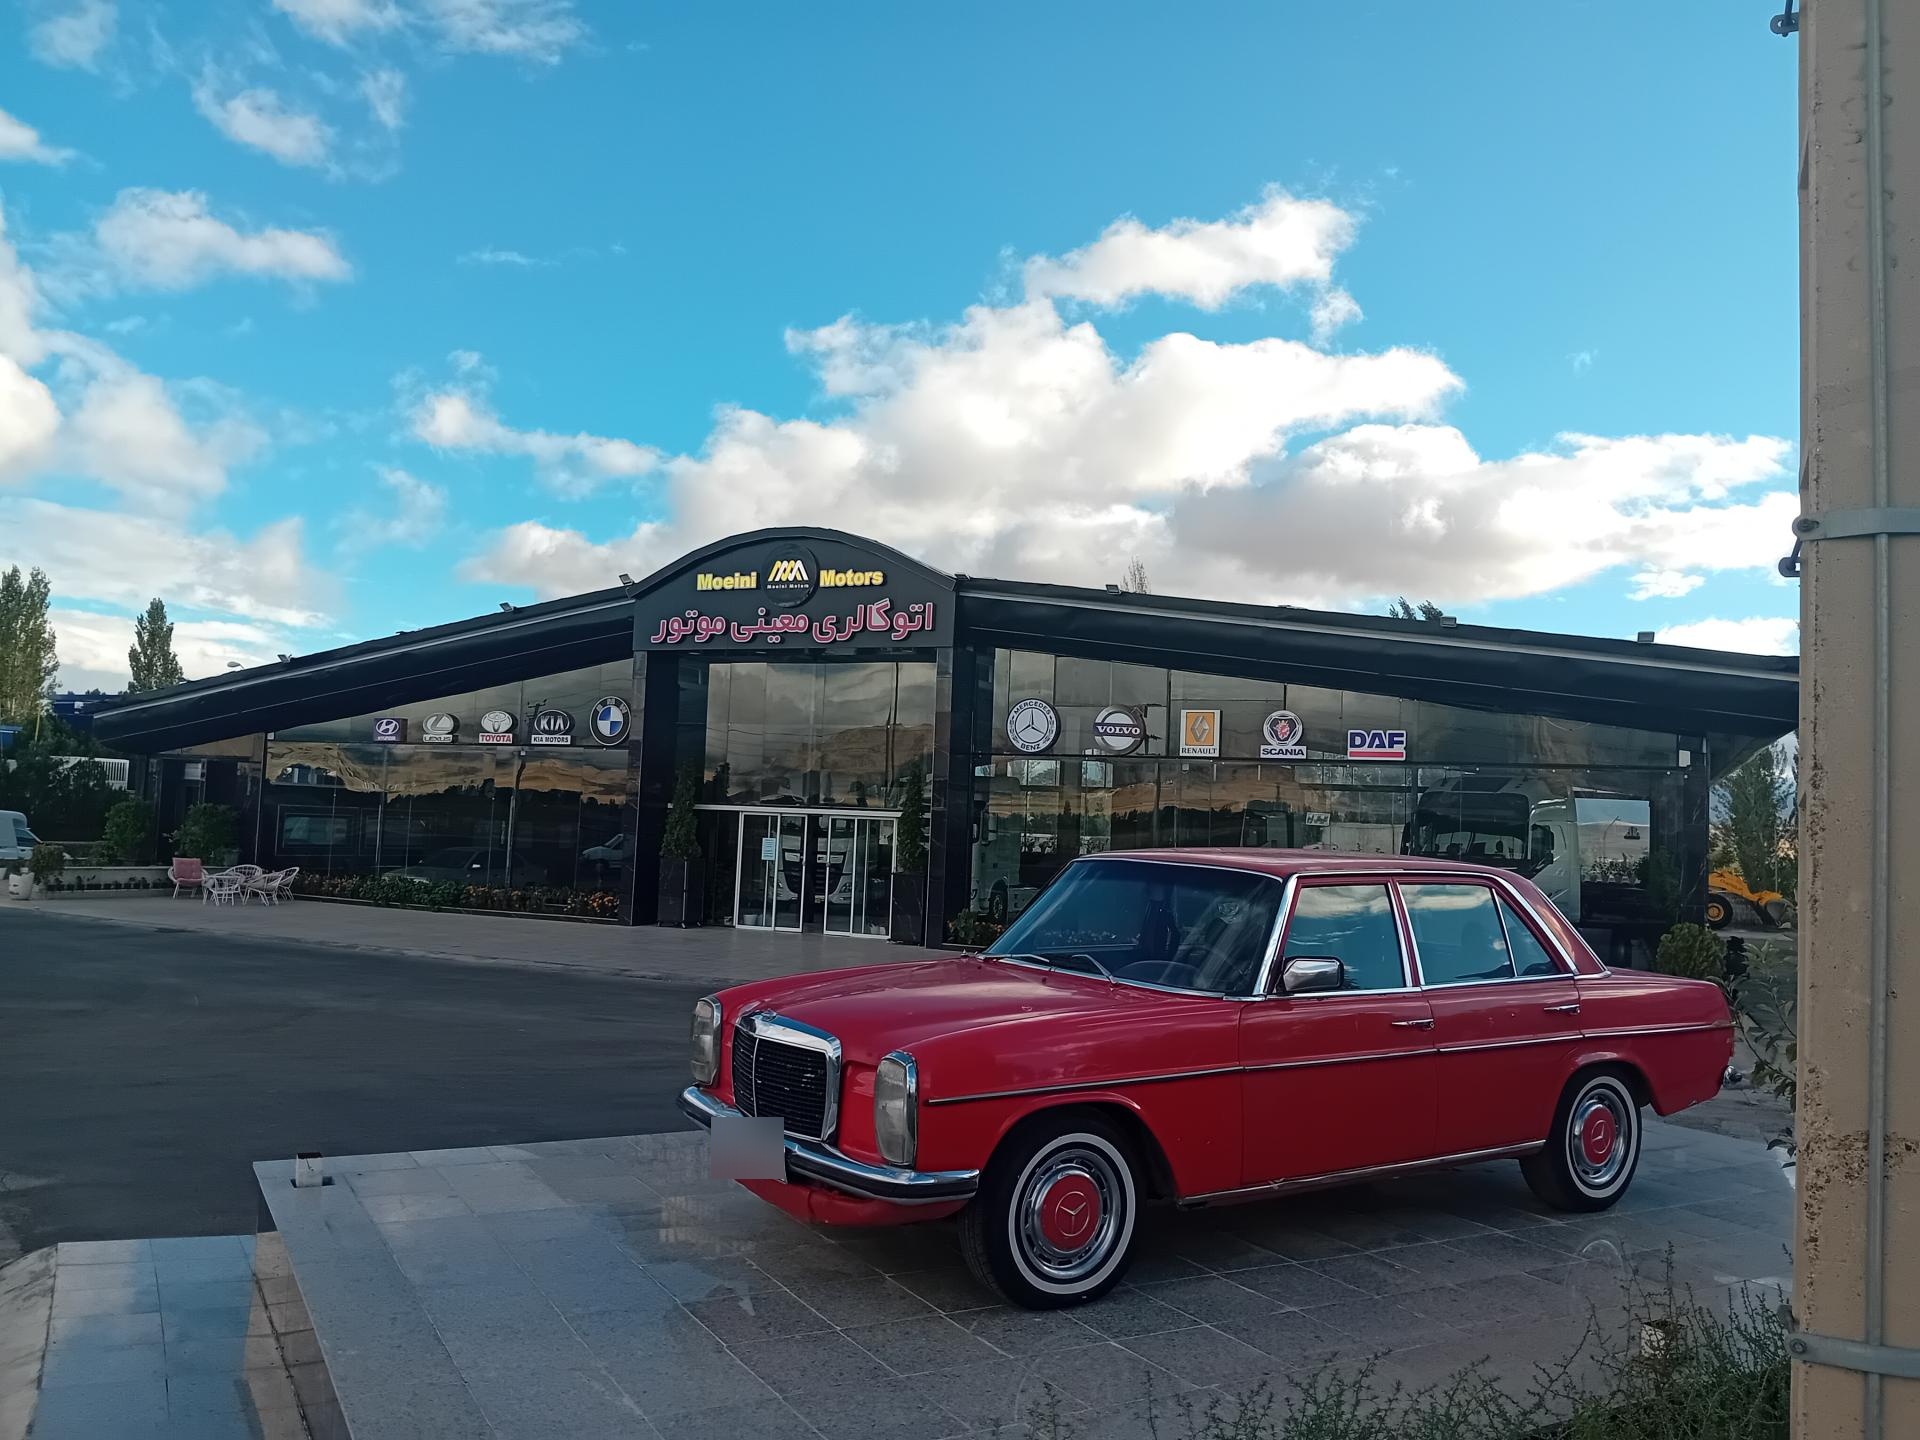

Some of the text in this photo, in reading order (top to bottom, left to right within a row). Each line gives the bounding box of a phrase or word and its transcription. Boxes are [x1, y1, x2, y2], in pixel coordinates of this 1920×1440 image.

[697, 568, 884, 591] Moeini Motors
[650, 609, 726, 643] موتور
[730, 607, 809, 644] معینی
[1013, 702, 1051, 716] MERCEDES
[540, 716, 565, 731] KIA
[1096, 725, 1140, 735] VOLVO
[481, 734, 512, 743] TOYOTA
[1349, 731, 1404, 749] DAF
[1020, 743, 1041, 751] BENZ
[1262, 748, 1304, 756] SCANIA
